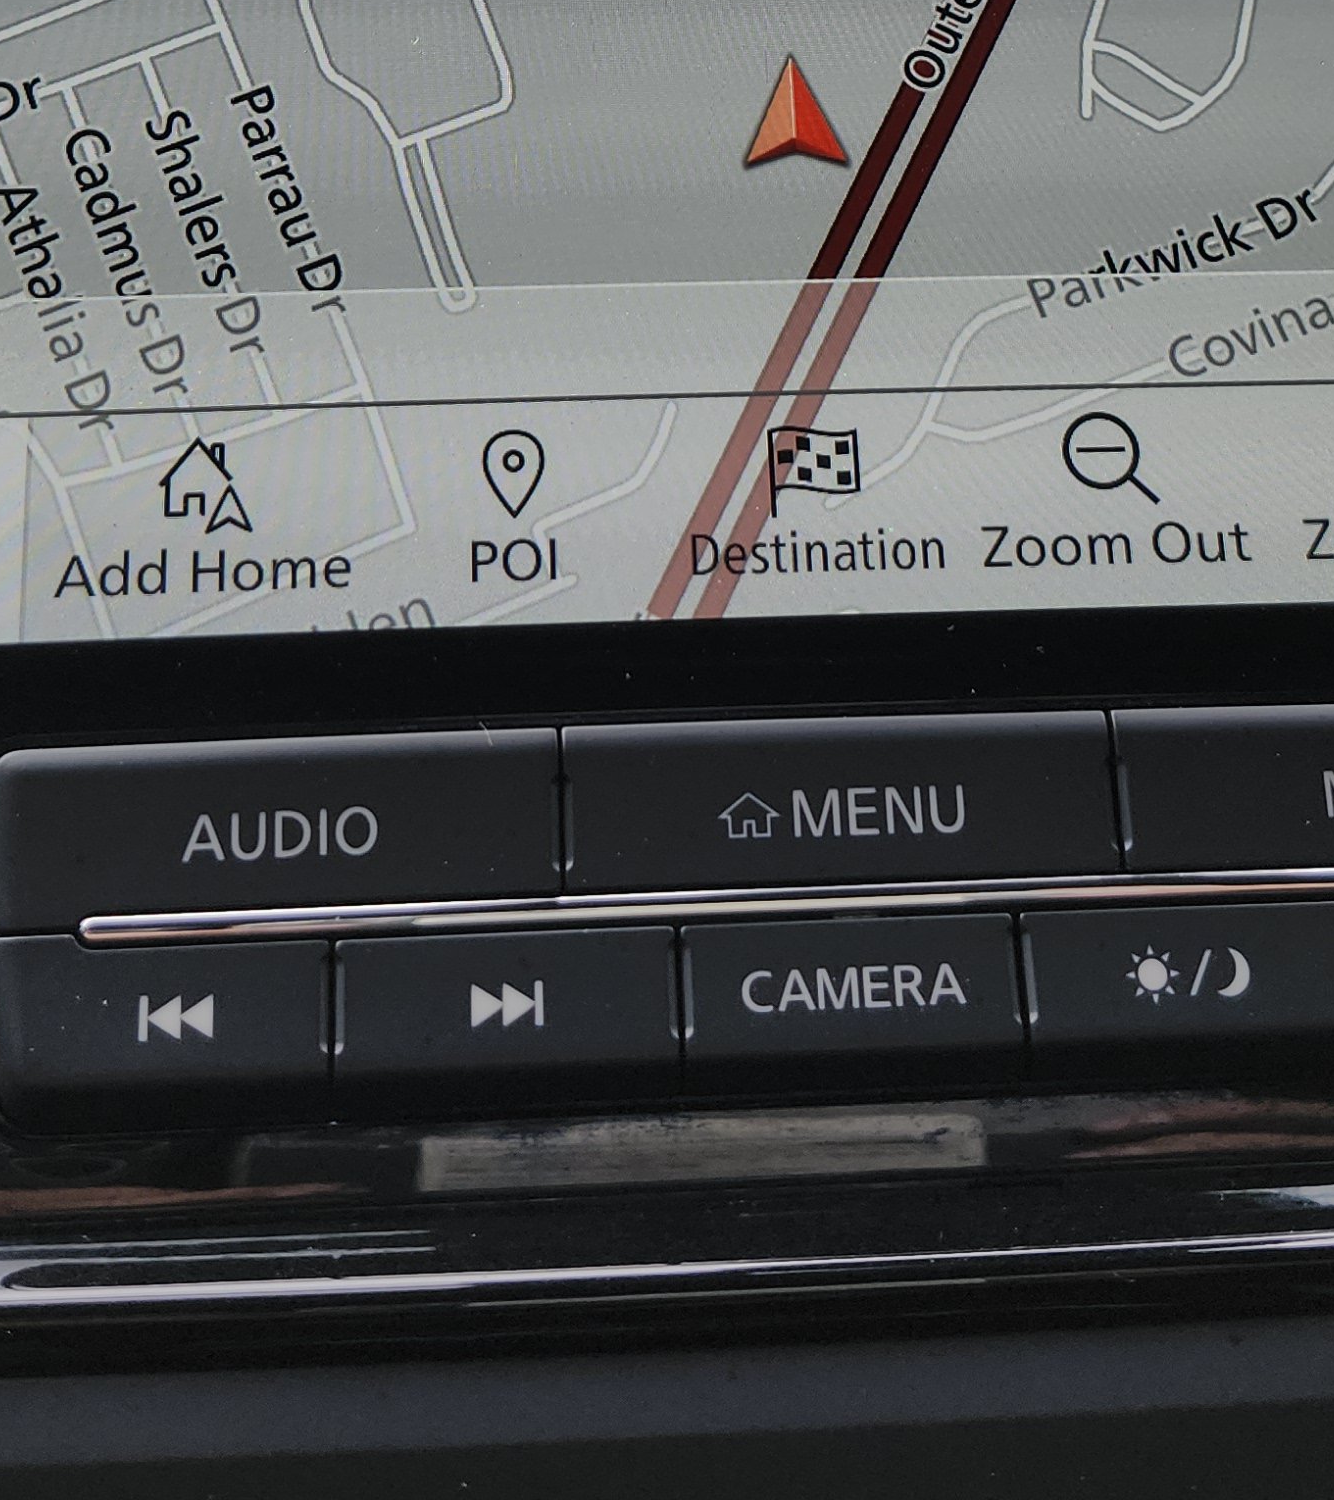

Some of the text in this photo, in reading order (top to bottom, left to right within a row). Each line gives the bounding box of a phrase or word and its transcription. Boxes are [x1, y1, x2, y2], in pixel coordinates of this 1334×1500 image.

[230, 84, 347, 313] Parrau Dr
[145, 110, 265, 353] Shalers Dr
[1027, 182, 1318, 320] Parkwick Dr
[66, 129, 189, 394] Cadmus Dr
[64, 370, 114, 431] Dr
[470, 539, 558, 583] POI
[690, 528, 945, 575] Destination
[982, 518, 1252, 568] Zoom Out
[55, 550, 352, 598] Add Home
[182, 807, 379, 864] AUDIO
[791, 784, 966, 838] MENU
[740, 962, 967, 1013] CAMERA
